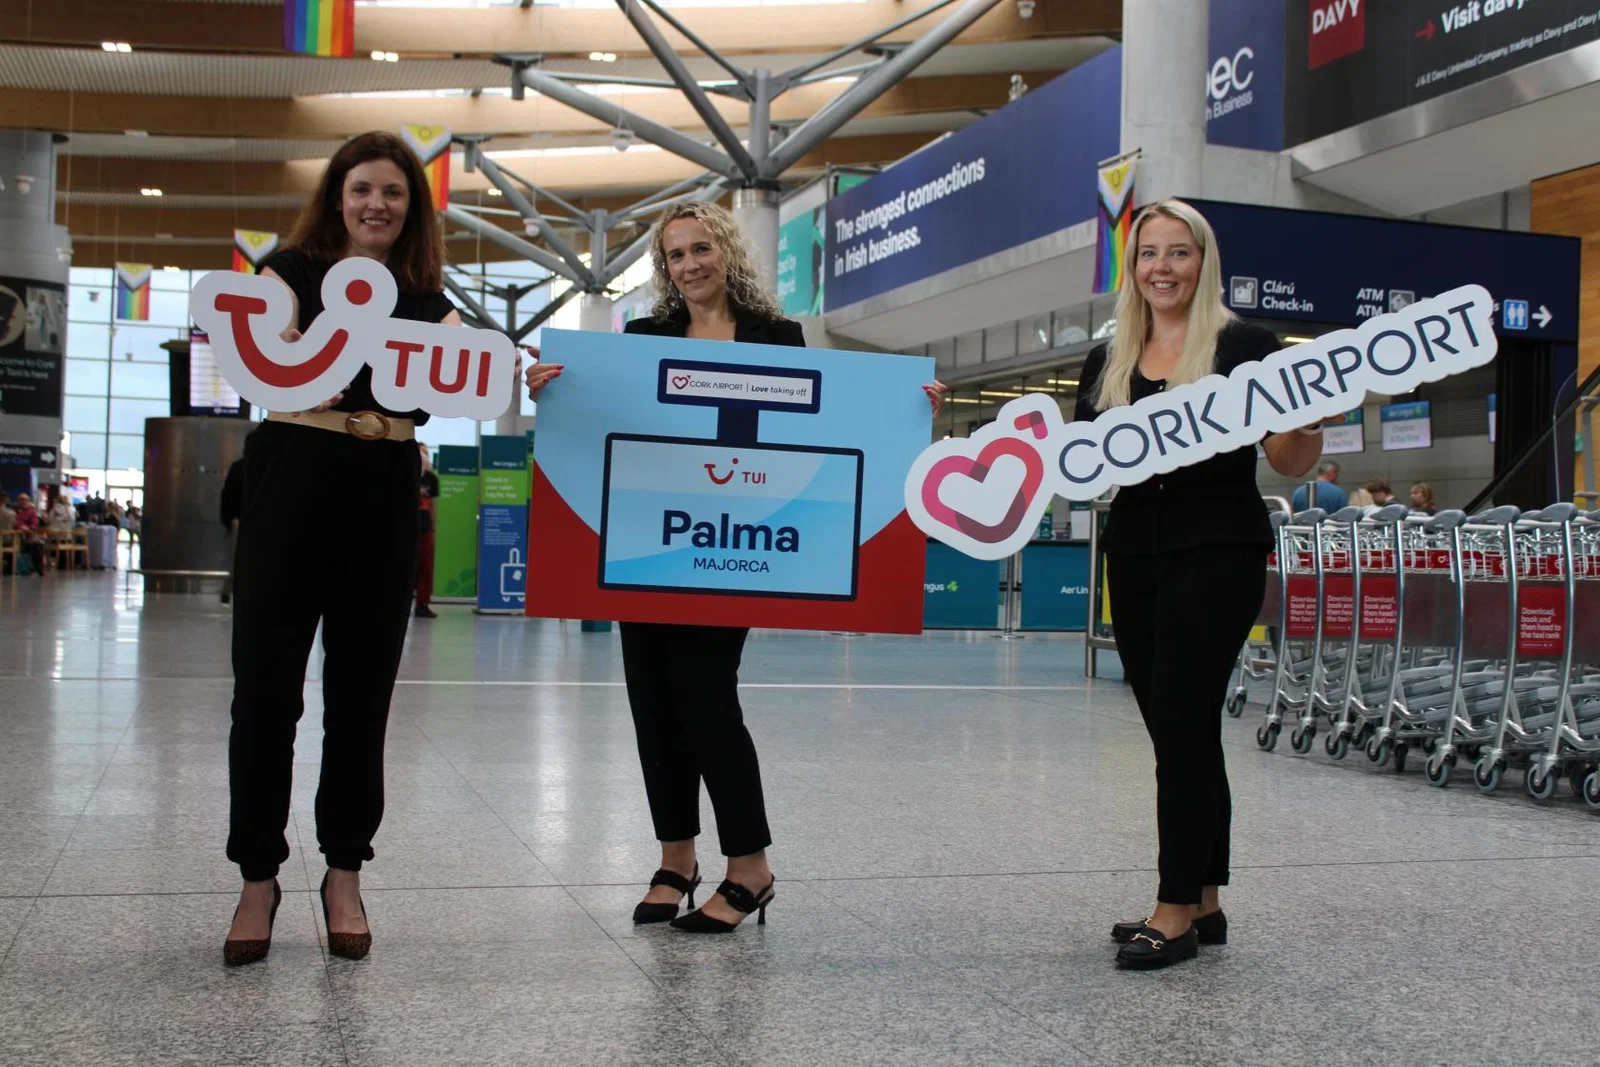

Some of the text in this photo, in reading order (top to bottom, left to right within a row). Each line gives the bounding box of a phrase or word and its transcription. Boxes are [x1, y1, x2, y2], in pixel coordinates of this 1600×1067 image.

[1312, 0, 1360, 35] DAVY
[1441, 3, 1480, 34] Visit
[1534, 34, 1543, 45] as
[1543, 27, 1562, 41] Davy
[1563, 18, 1578, 34] and
[1578, 13, 1597, 28] Davy
[1206, 46, 1254, 100] ec
[1213, 90, 1254, 119] Business
[836, 218, 854, 244] The
[855, 191, 906, 235] strongest
[907, 157, 985, 212] connections
[834, 226, 921, 277] in Irish business.
[1262, 279, 1295, 295] Clárú
[1356, 287, 1384, 302] ATM
[1261, 297, 1314, 313] Check-in
[1355, 304, 1383, 317] ATM
[385, 340, 492, 397] TUI
[689, 380, 807, 397] CORK AIRPORT Love taking off
[1059, 301, 1480, 485] CORK AIRPORT
[742, 471, 766, 484] TUI
[662, 509, 800, 553] Palma
[693, 557, 770, 573] MAJORCA
[925, 583, 945, 593] ngus
[1060, 586, 1075, 595] Aer
